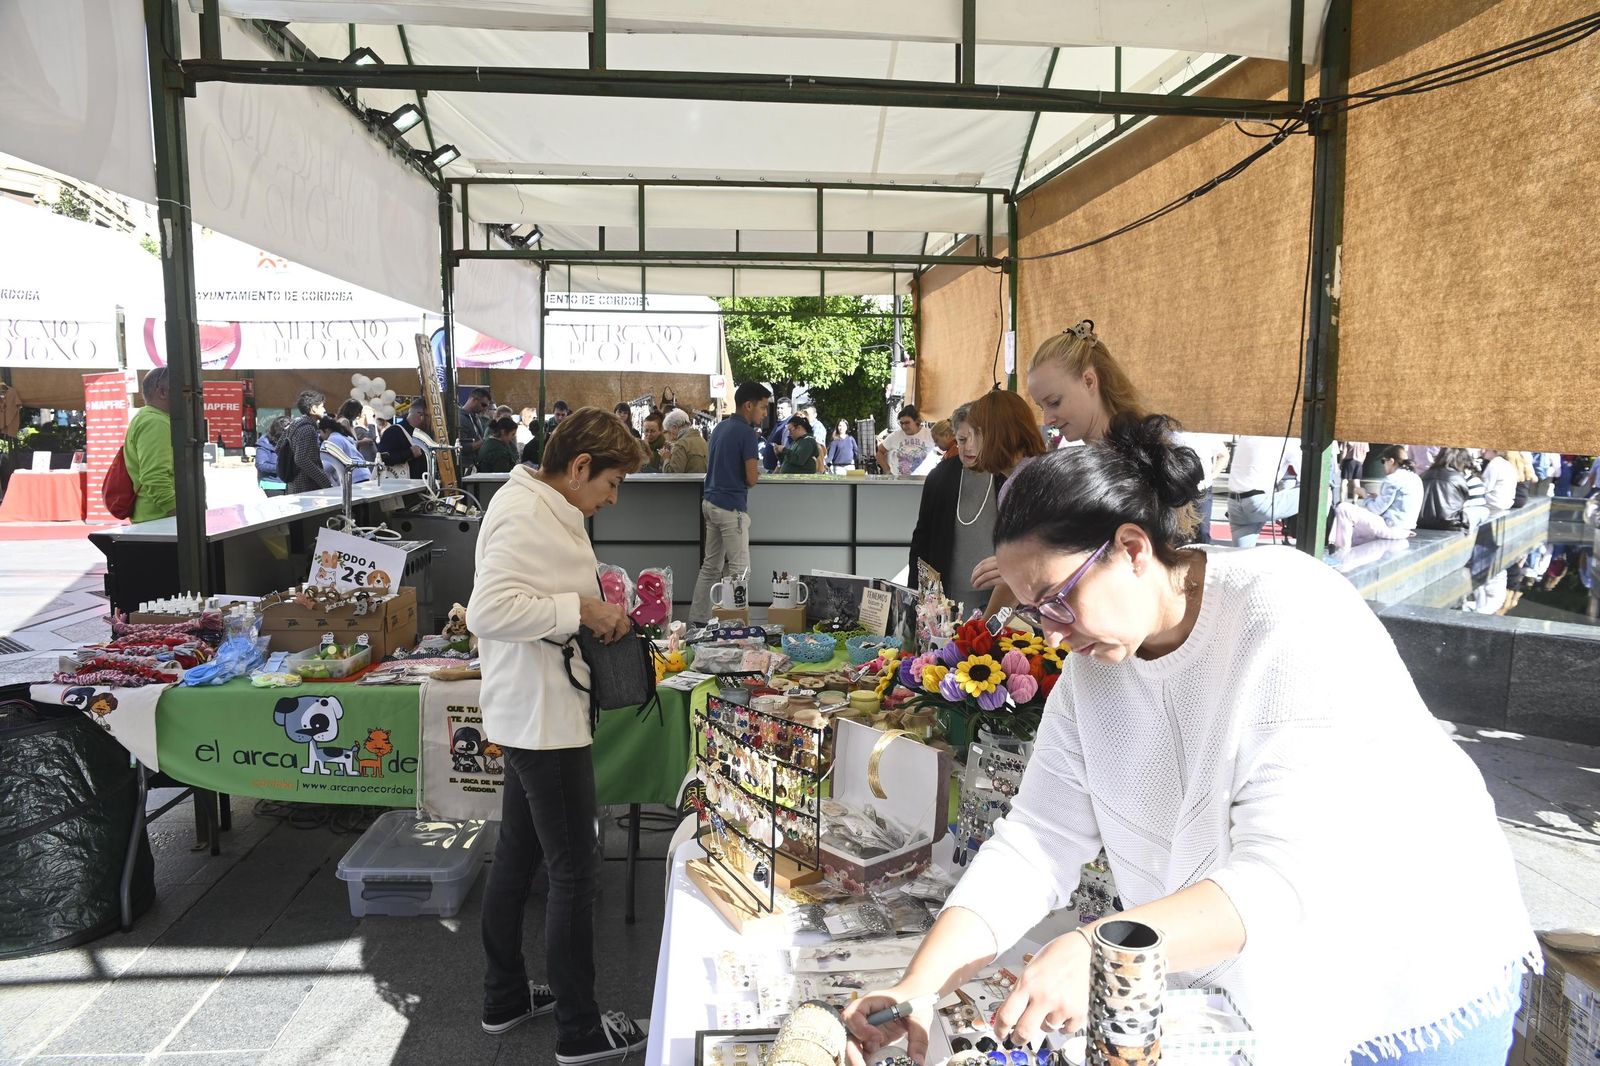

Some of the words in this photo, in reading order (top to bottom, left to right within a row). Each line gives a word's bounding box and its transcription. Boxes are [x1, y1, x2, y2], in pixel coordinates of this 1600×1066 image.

[196, 291, 281, 301] AYUNTAMIENTO
[285, 291, 298, 301] DE
[582, 295, 595, 305] DE
[91, 400, 126, 411] MAPFRE
[336, 551, 367, 567] TODO
[368, 560, 376, 570] A
[341, 566, 367, 587] 2€
[446, 705, 465, 714] QUE
[467, 706, 478, 714] TU
[451, 715, 462, 723] TE
[195, 739, 220, 763] el
[233, 749, 298, 769] arca
[388, 750, 419, 774] de
[462, 785, 497, 794] CÓRDOBA
